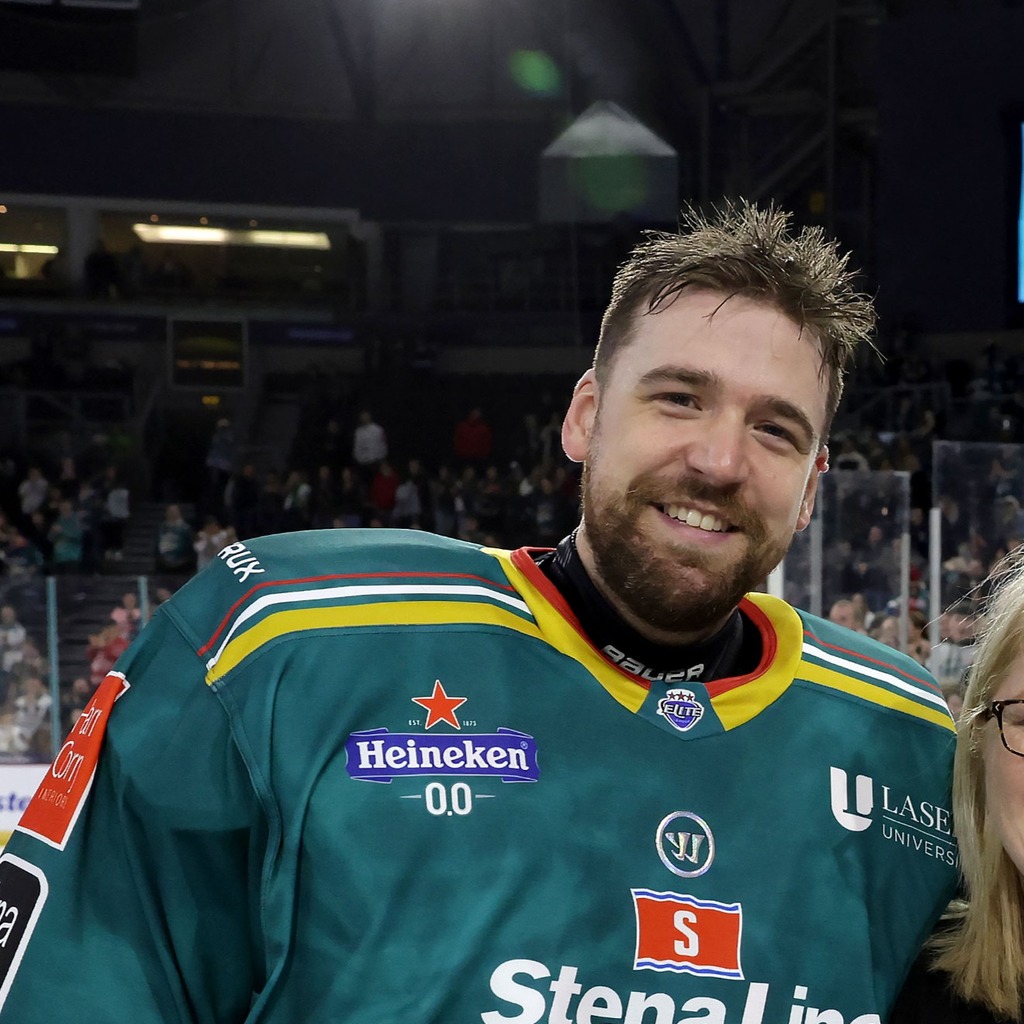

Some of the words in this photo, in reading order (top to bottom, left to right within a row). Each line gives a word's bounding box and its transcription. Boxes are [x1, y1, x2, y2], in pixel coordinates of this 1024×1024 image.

[663, 703, 703, 719] ELITE
[356, 739, 530, 771] Heineken
[424, 782, 473, 816] 0.0
[882, 785, 956, 835] LASE
[673, 910, 699, 957] S
